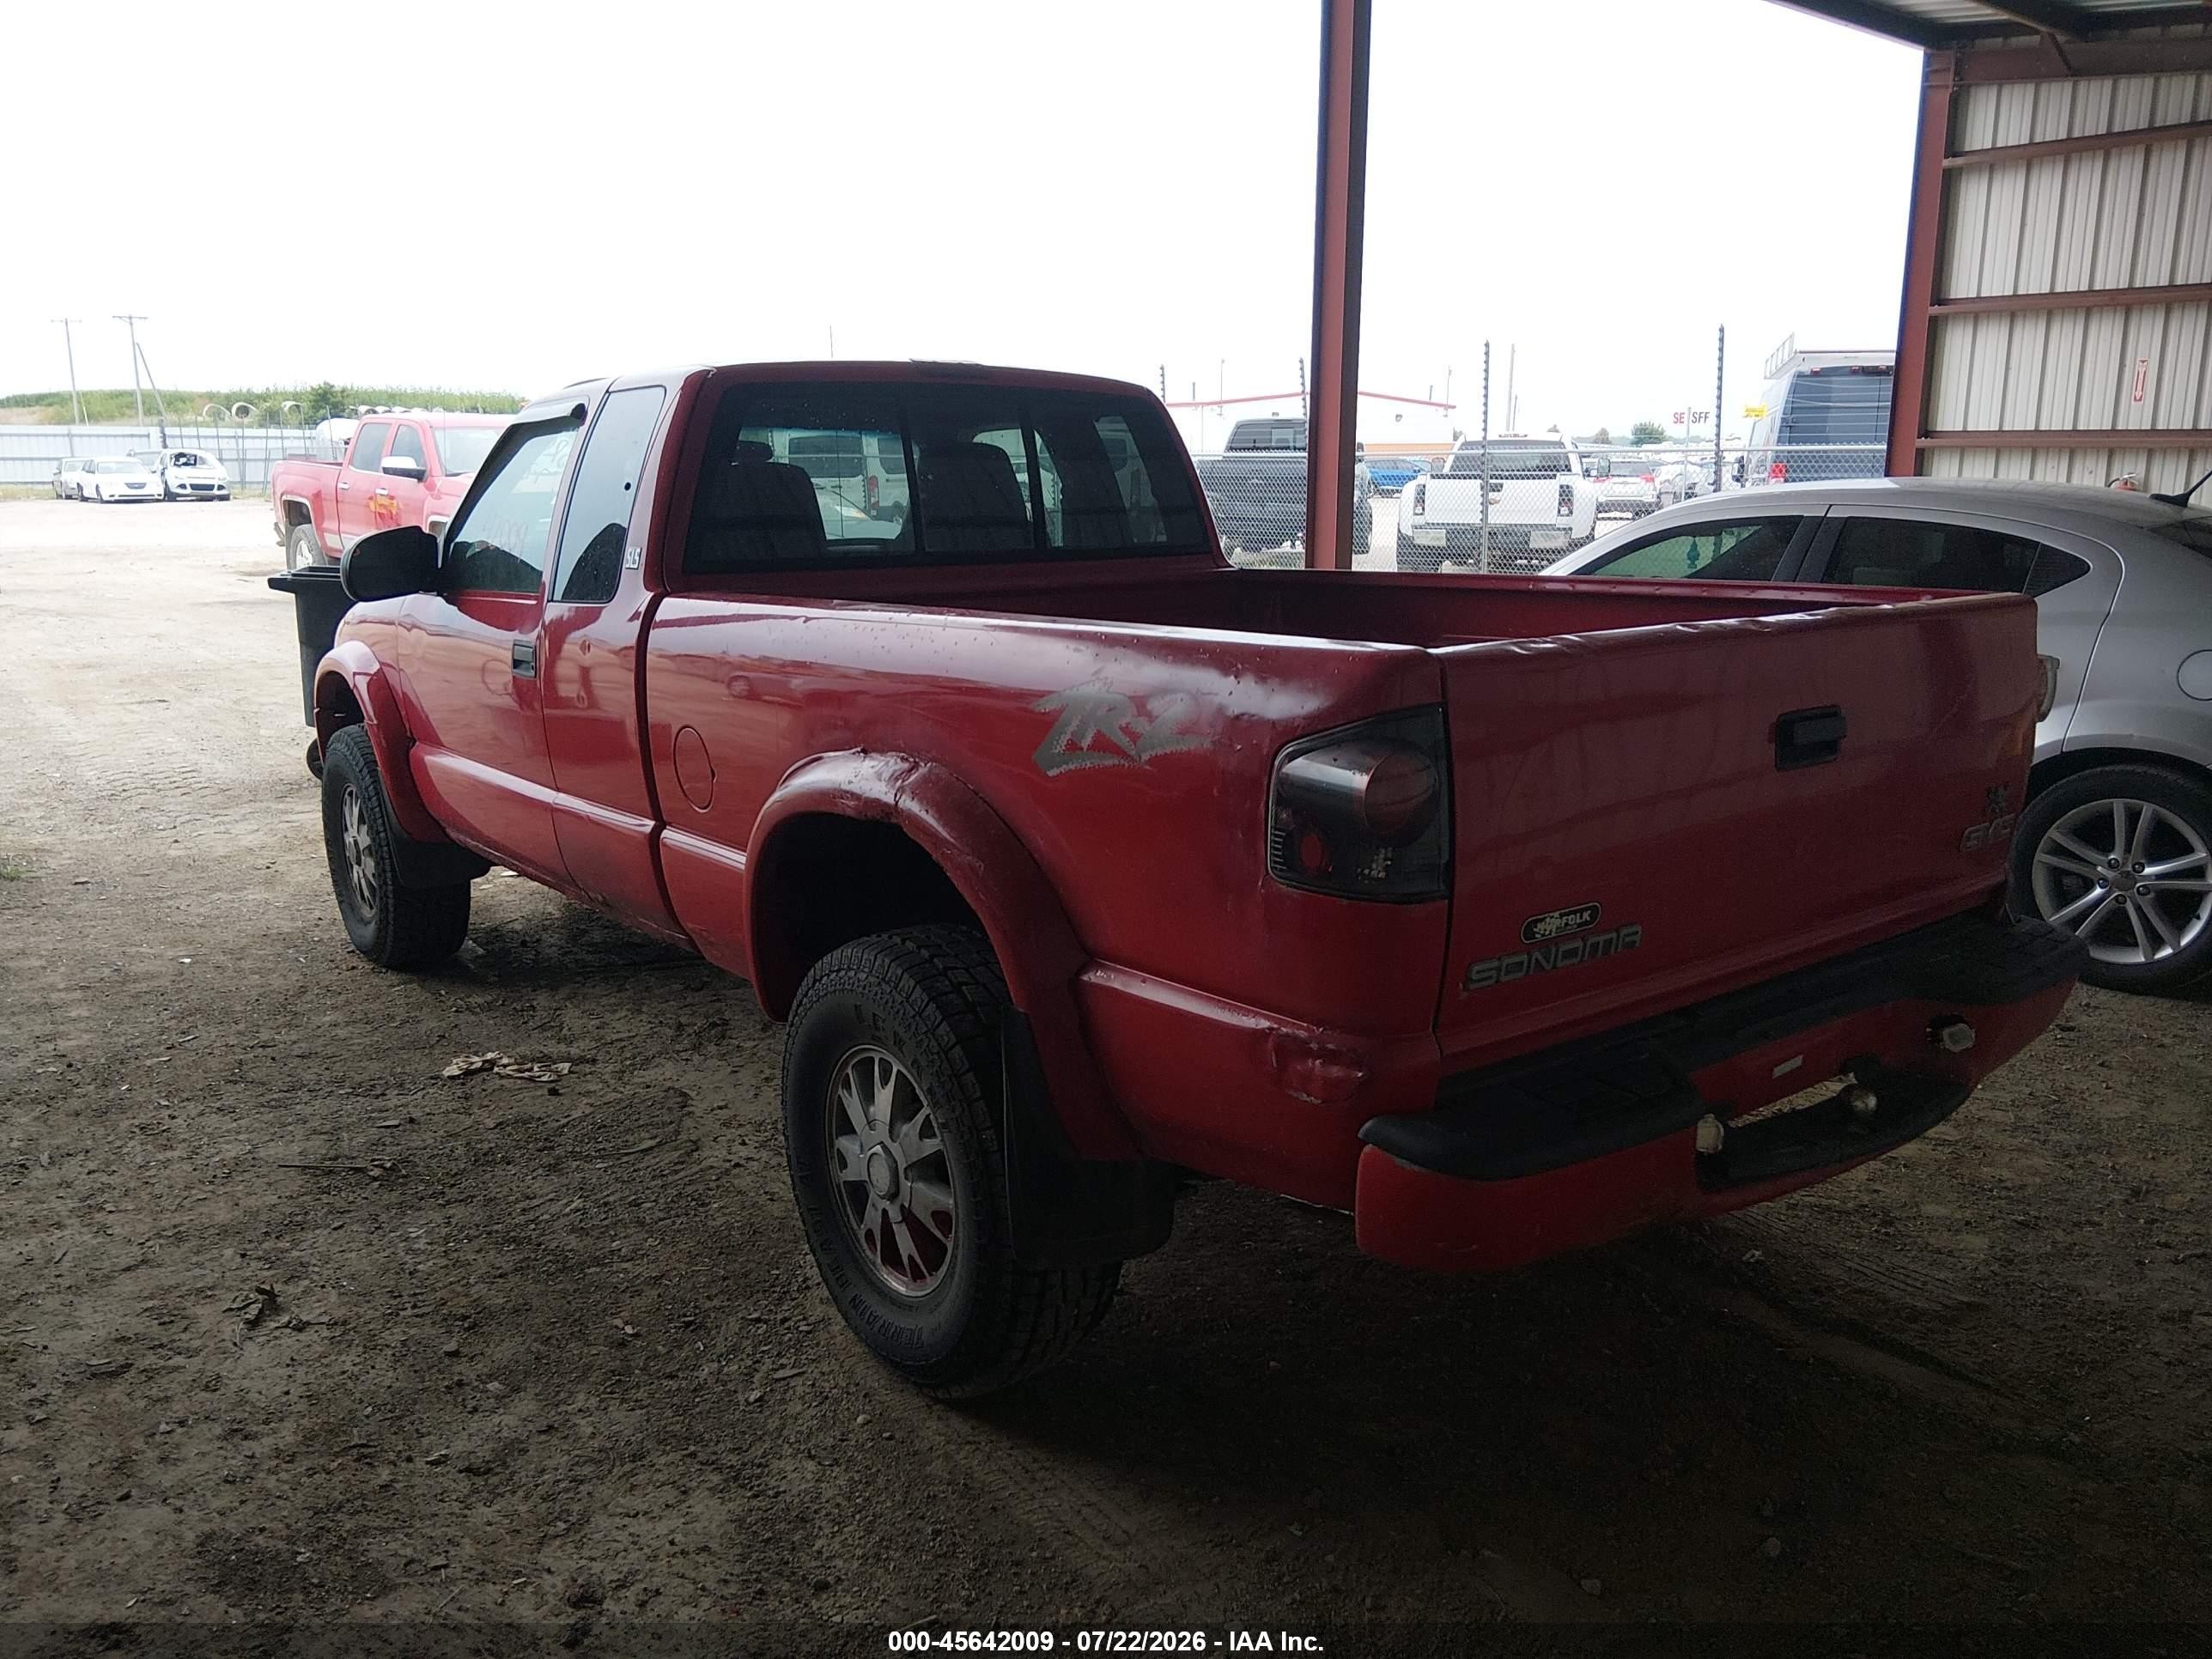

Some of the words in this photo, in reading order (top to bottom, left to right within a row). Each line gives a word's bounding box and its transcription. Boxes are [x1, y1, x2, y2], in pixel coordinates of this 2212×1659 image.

[1672, 411, 1686, 425] SE
[1691, 411, 1711, 425] SFF
[1466, 924, 1643, 990] SONOMA
[849, 1293, 926, 1349] TERRAIN
